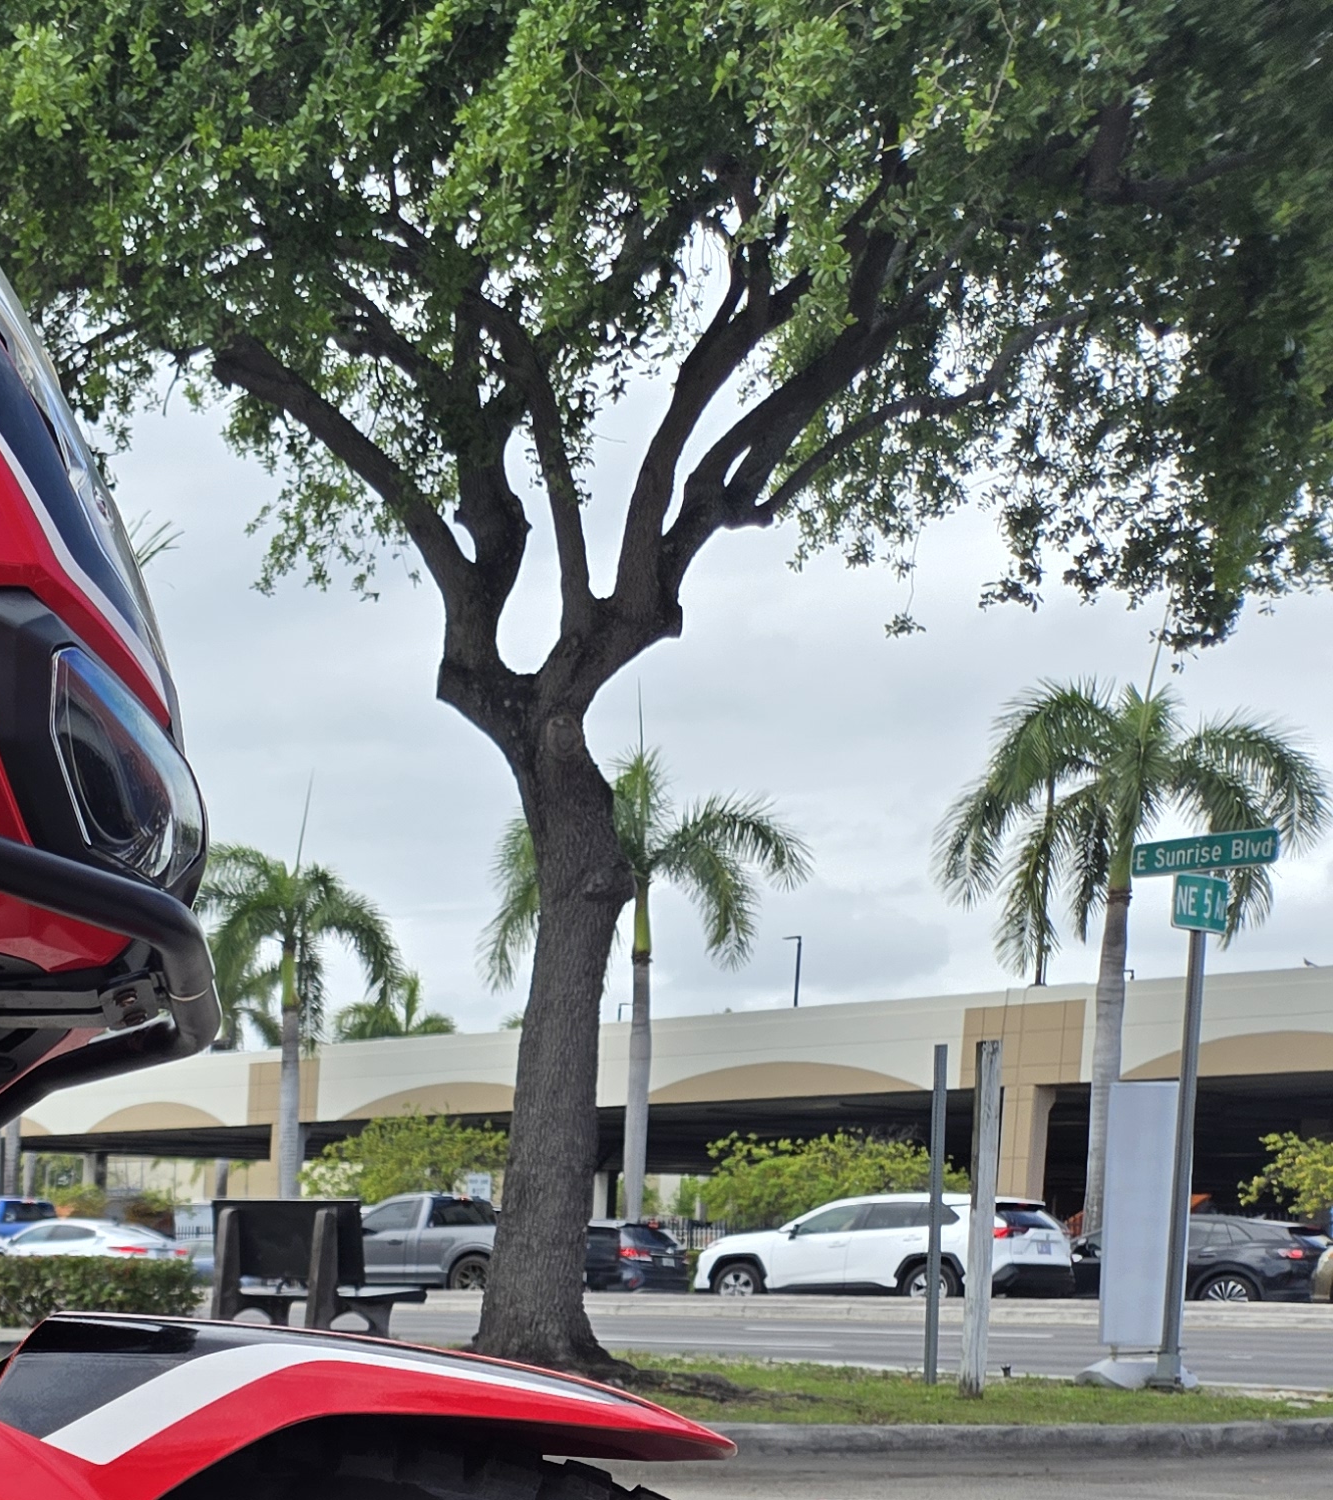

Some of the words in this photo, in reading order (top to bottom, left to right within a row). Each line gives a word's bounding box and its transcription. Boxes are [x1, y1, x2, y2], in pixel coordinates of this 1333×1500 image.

[1136, 850, 1148, 871] E
[1154, 844, 1221, 869] Sunrise
[1231, 836, 1273, 860] Blvd
[1176, 885, 1198, 917] NE
[1203, 888, 1212, 919] 5
